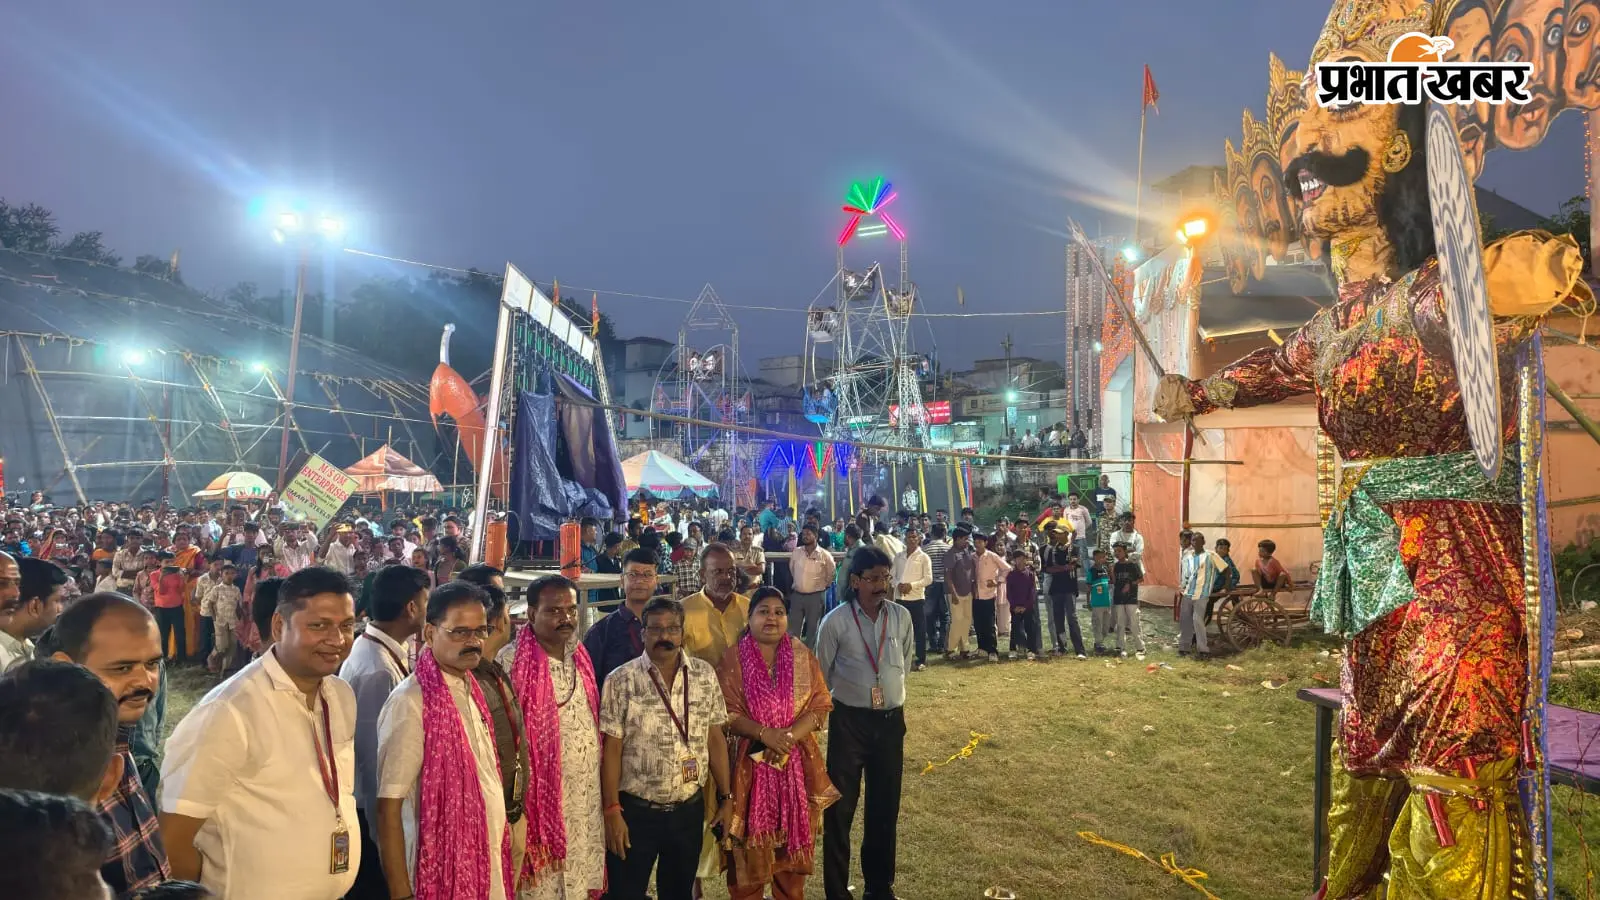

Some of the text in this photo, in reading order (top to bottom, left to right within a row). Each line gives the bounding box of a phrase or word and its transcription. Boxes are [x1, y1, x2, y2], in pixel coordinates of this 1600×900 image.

[300, 466, 349, 502] ENTERPRISES
[318, 463, 349, 486] M/S OM
